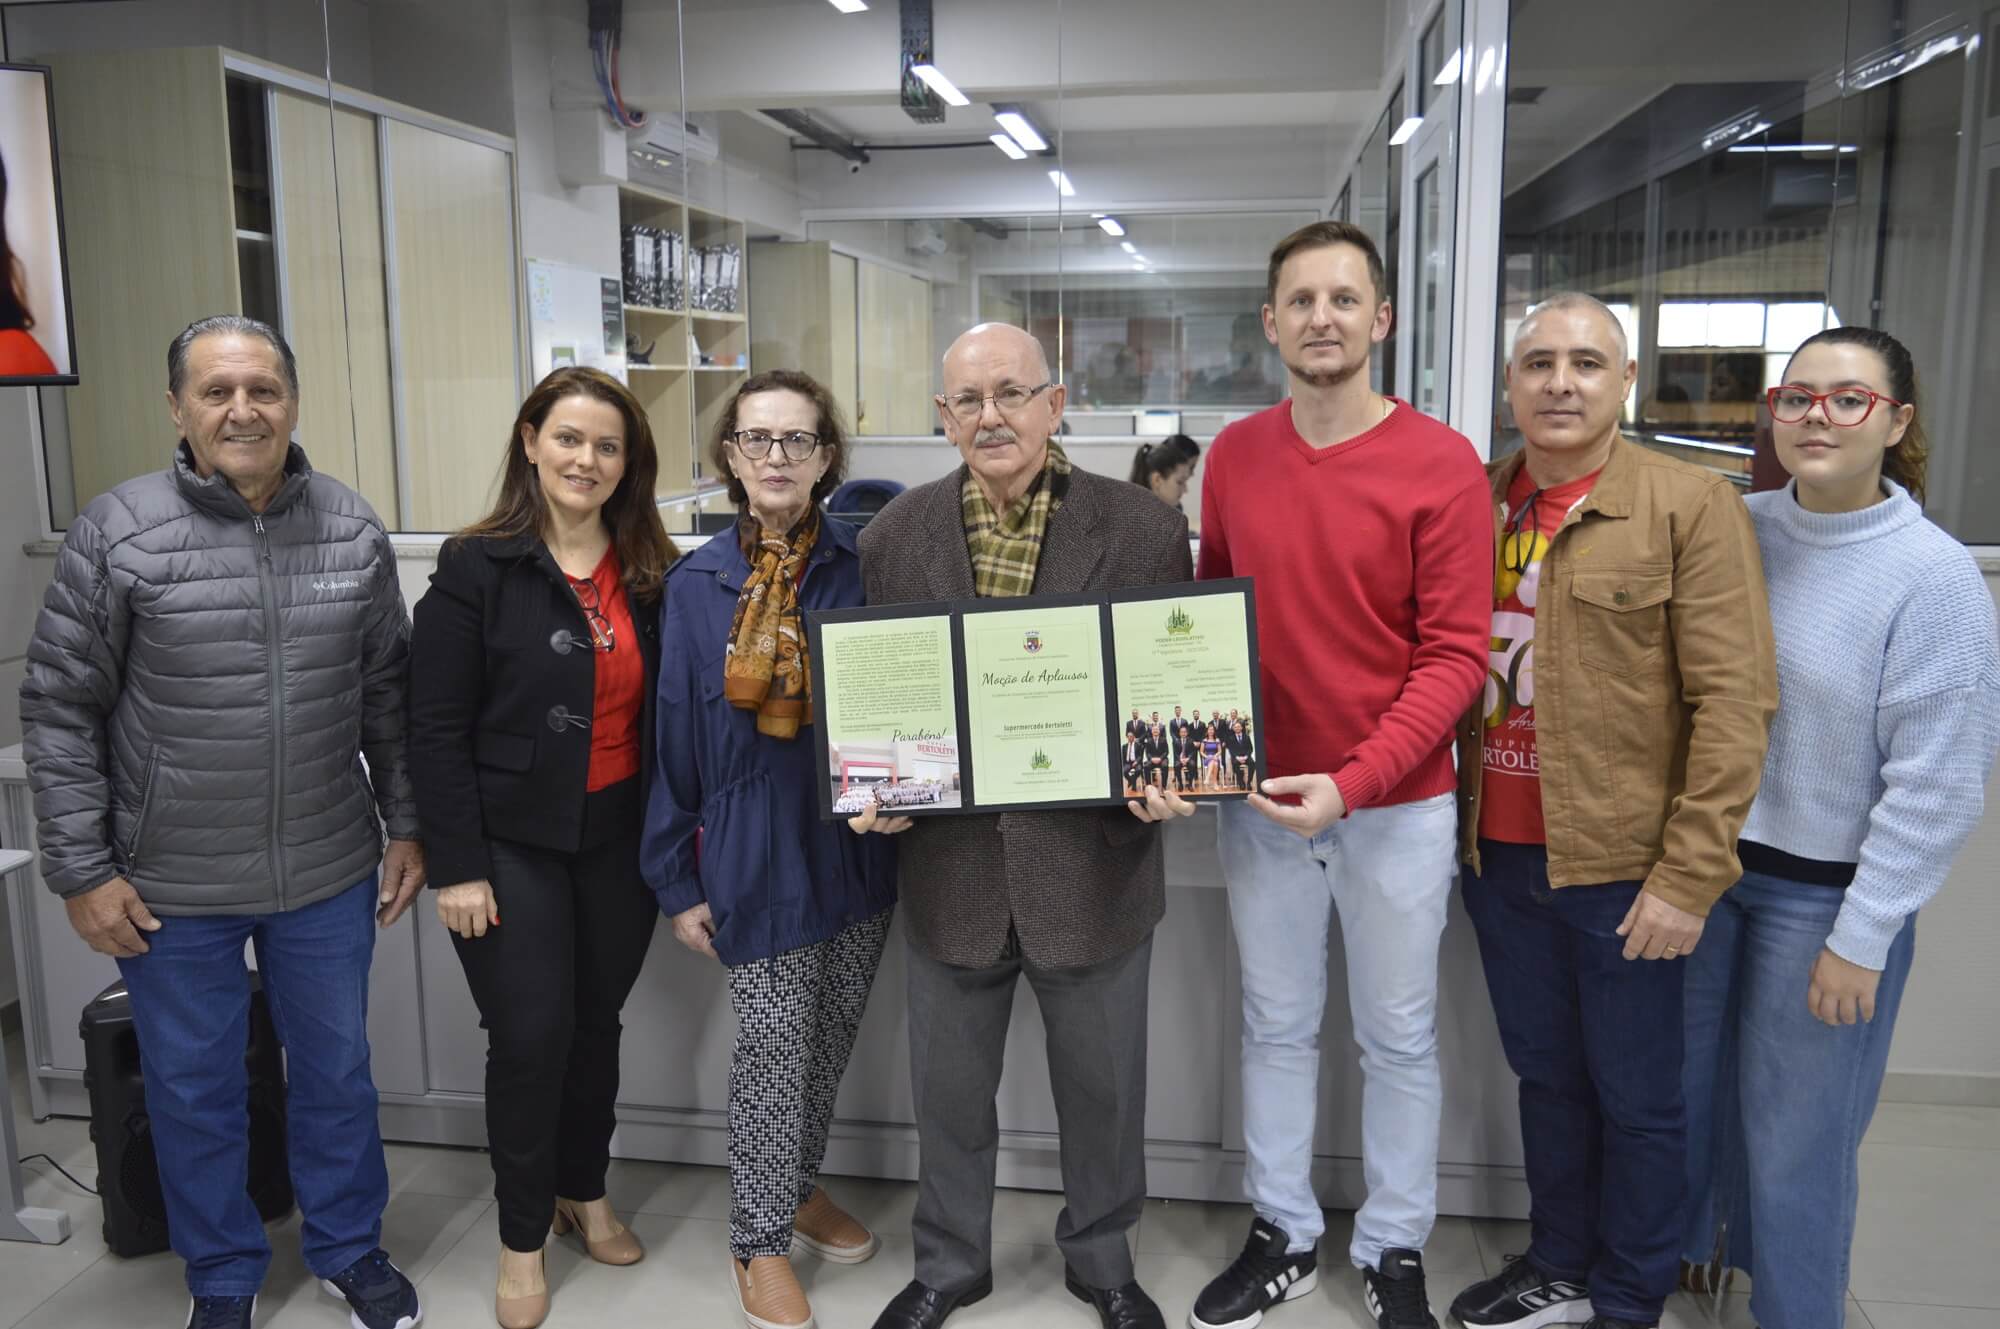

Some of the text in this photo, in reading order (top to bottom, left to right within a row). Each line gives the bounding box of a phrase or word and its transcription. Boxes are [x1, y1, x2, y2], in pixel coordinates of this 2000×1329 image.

[320, 580, 359, 590] Columbia
[982, 668, 1088, 687] Moção de Aplausos
[893, 728, 947, 742] Parabéns!
